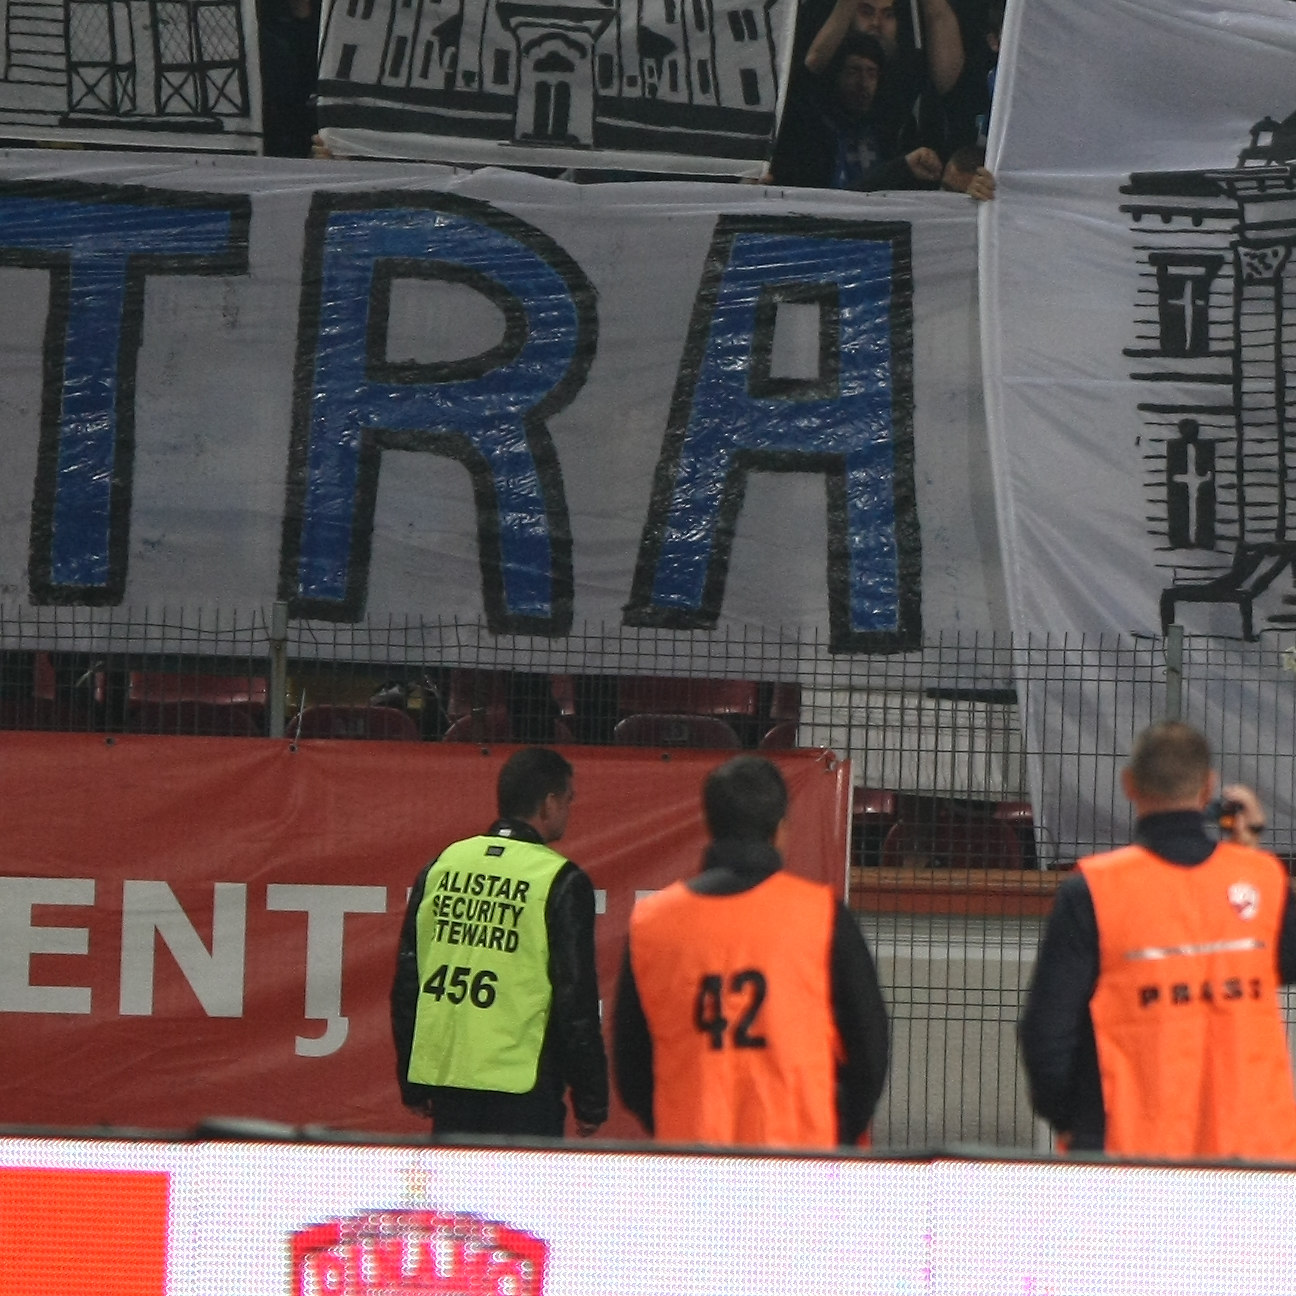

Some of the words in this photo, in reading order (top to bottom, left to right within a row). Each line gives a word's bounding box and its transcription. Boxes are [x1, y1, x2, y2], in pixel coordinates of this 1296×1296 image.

[437, 871, 530, 903] ALISTAR
[432, 894, 525, 928] SECURITY
[431, 919, 520, 954] TEWARD
[422, 964, 499, 1009] 456
[693, 969, 767, 1051] 42
